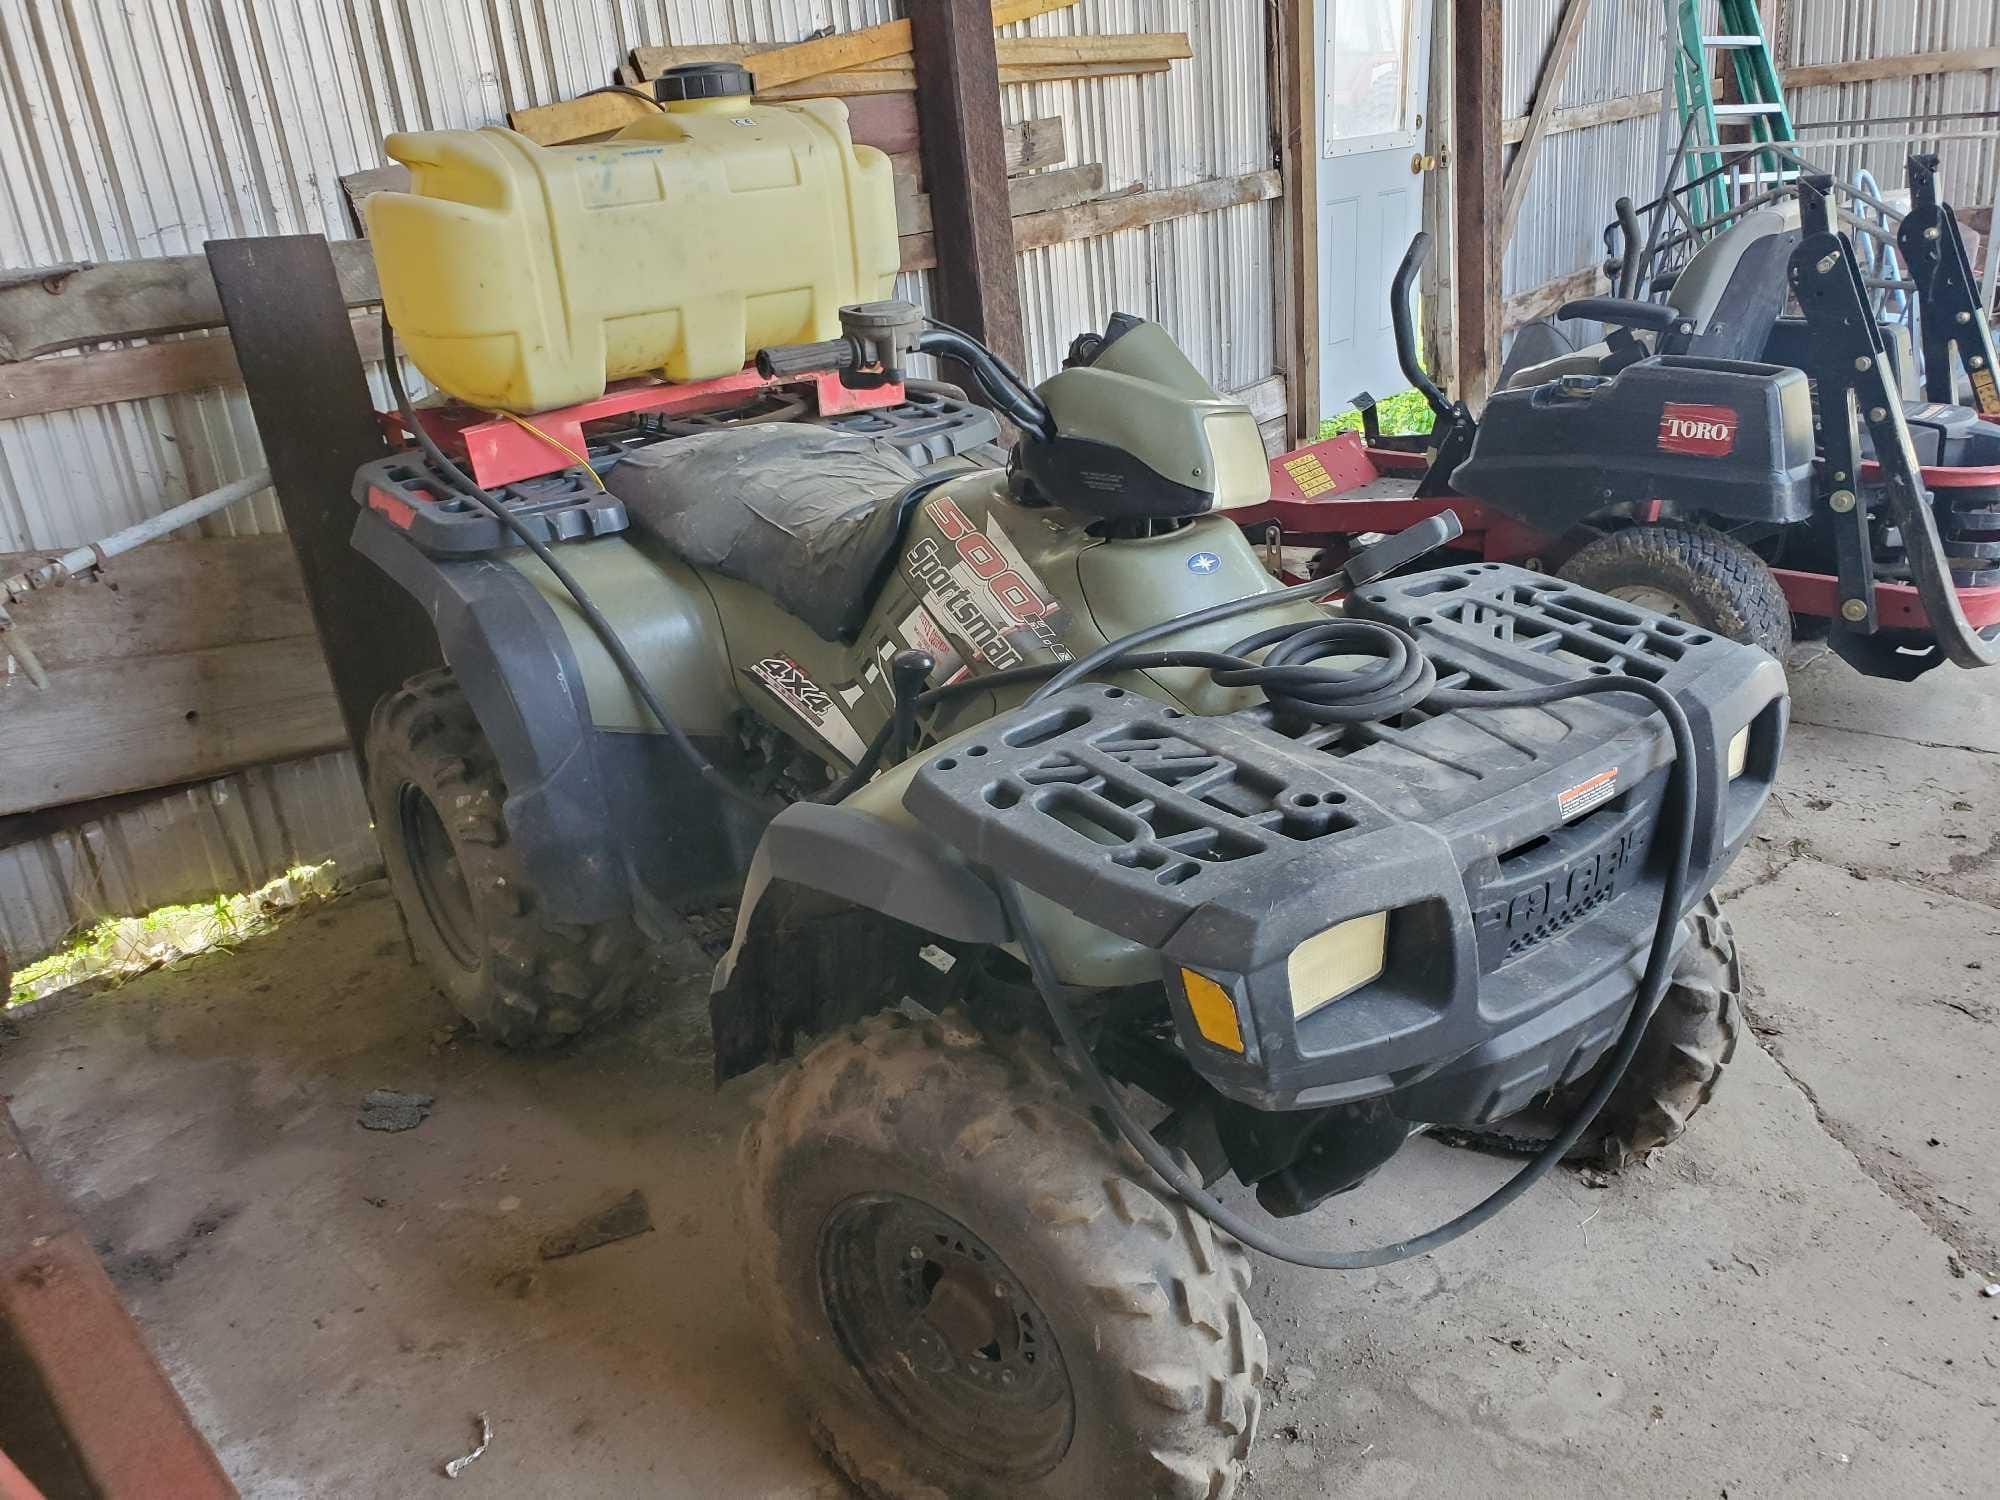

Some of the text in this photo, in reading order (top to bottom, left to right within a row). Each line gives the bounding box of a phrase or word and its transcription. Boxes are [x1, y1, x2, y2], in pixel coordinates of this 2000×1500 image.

[1667, 419, 1729, 441] TORO
[906, 537, 1024, 670] Sportsman
[924, 496, 1046, 622] 500
